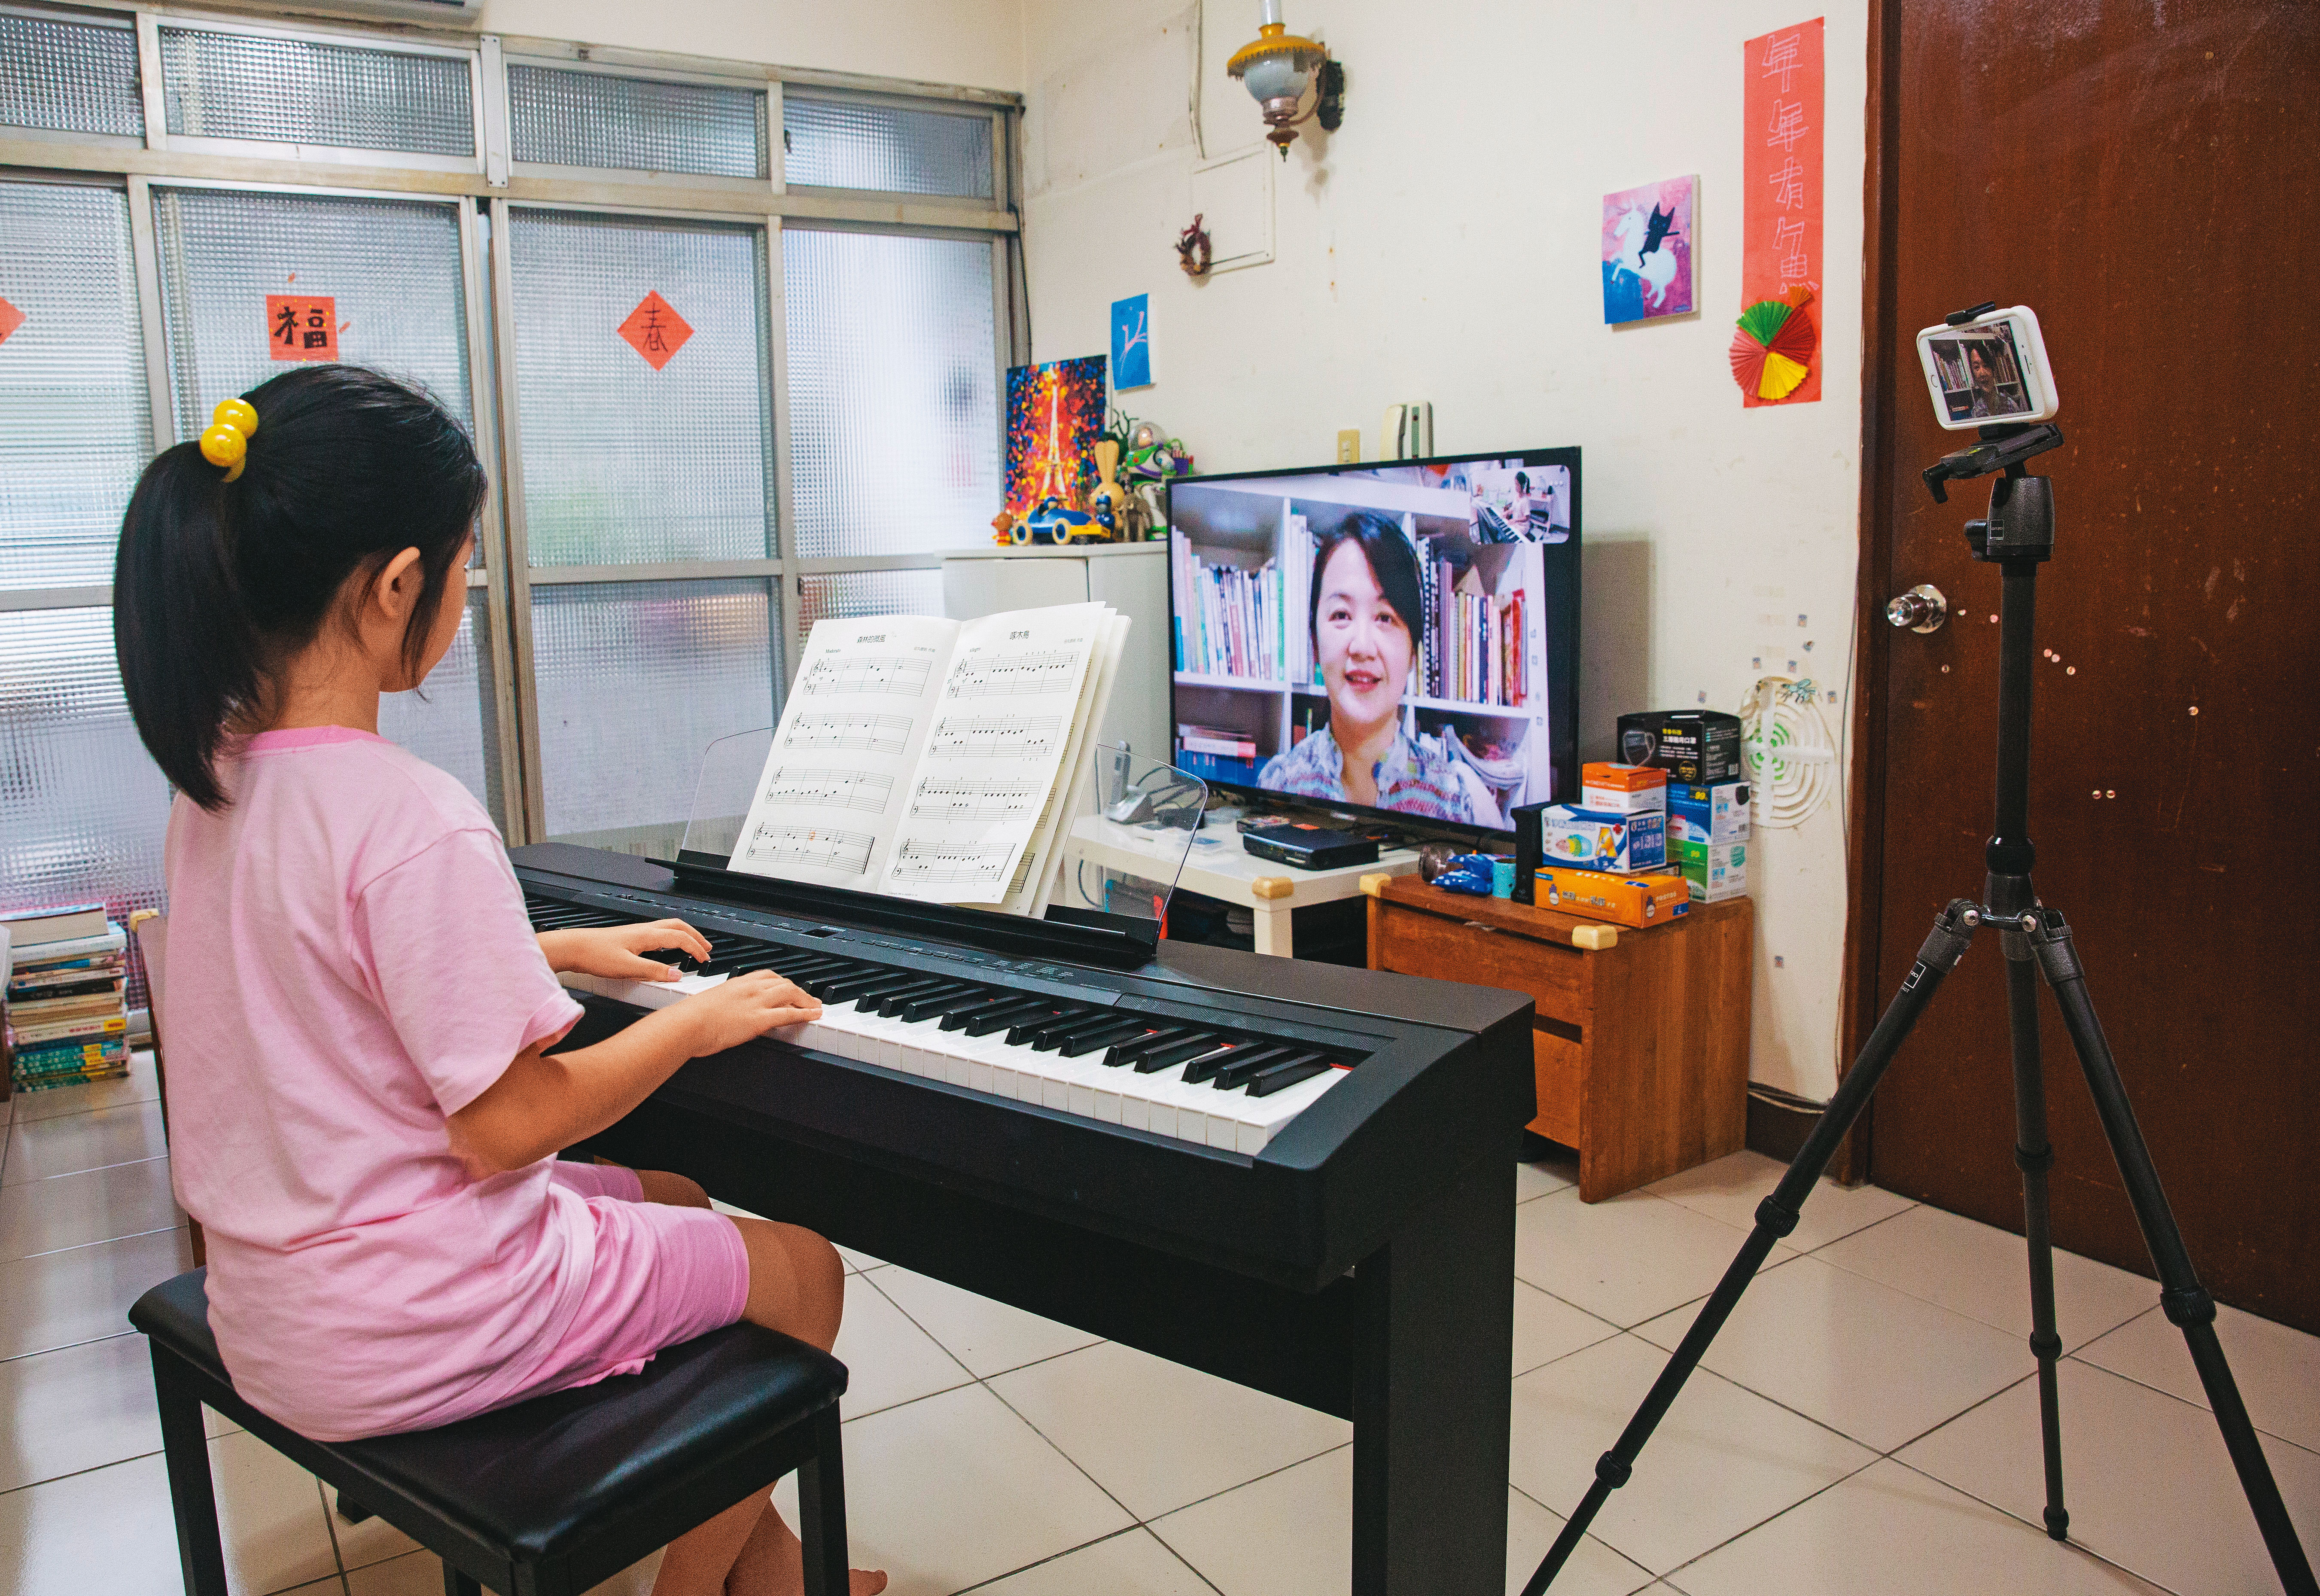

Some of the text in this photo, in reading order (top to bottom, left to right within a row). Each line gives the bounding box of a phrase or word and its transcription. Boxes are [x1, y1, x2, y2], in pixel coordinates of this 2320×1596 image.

[274, 307, 328, 349] 福
[640, 302, 668, 352] 春
[857, 635, 886, 643] 森林的微風
[1010, 630, 1029, 640] 啄木鳥
